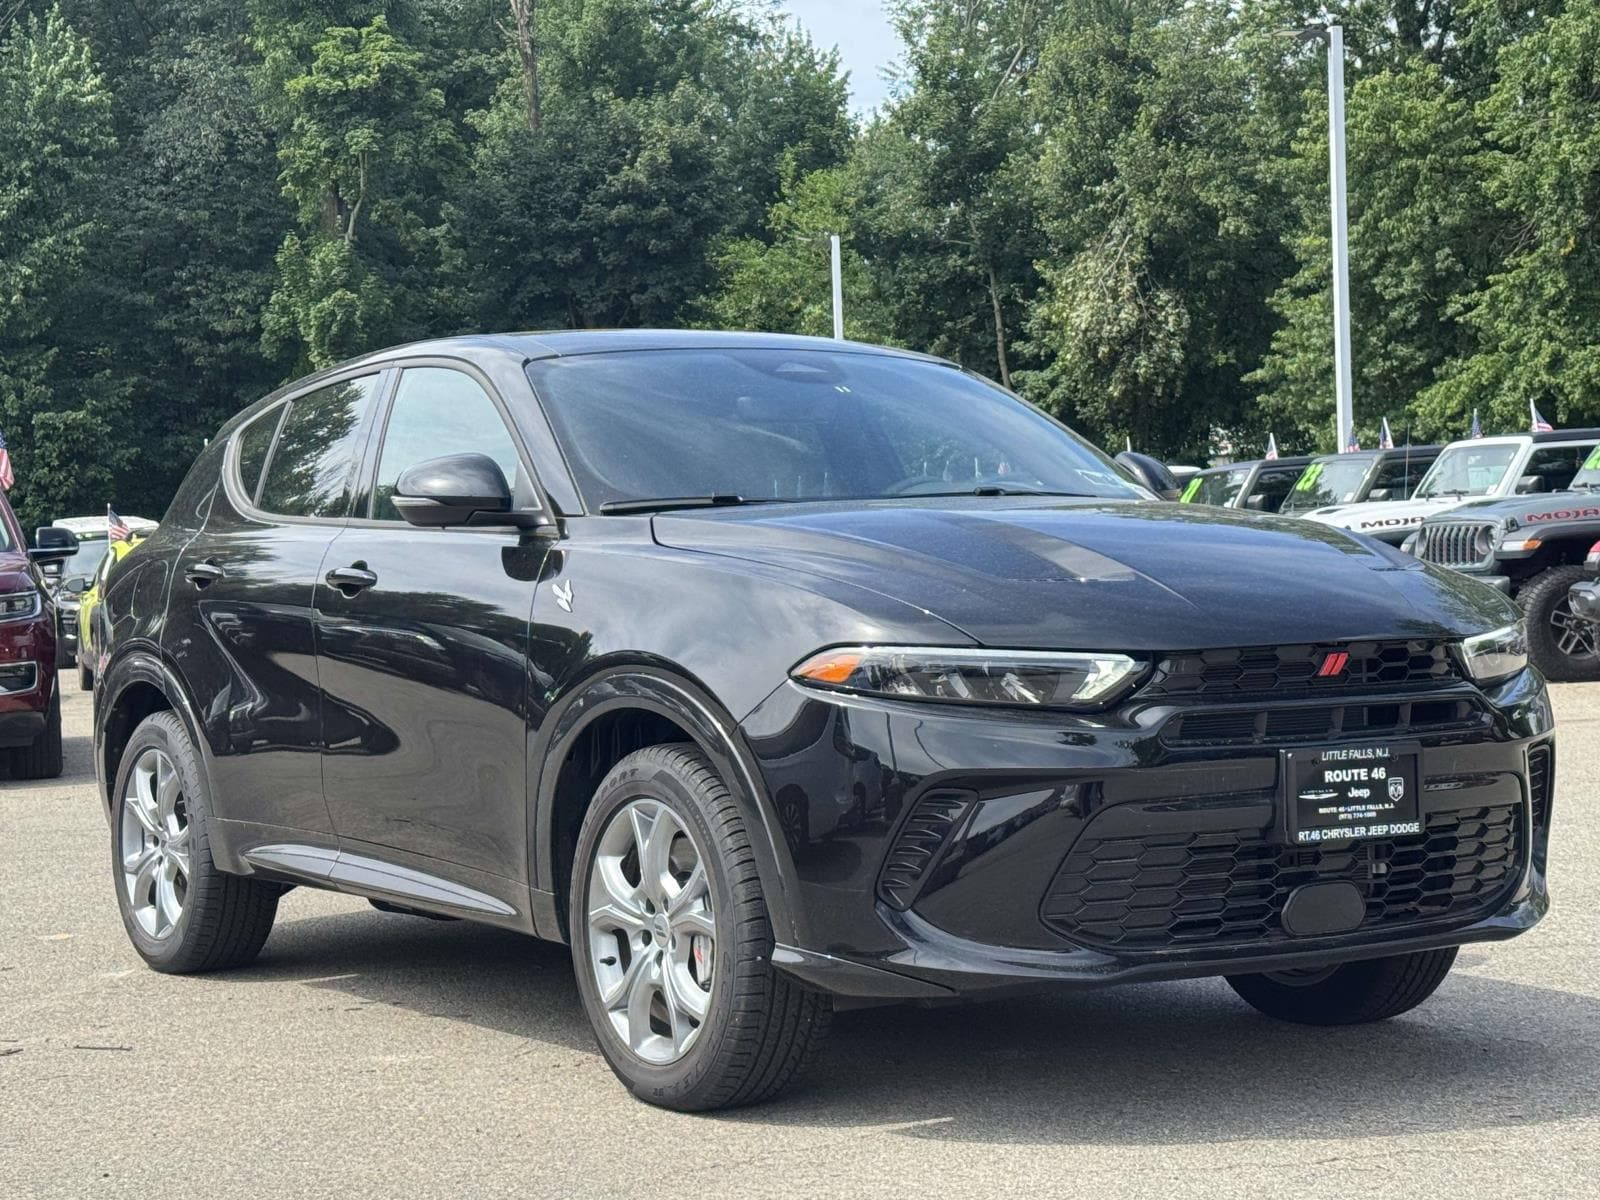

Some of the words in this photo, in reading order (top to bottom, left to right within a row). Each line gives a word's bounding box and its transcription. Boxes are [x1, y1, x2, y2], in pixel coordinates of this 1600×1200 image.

[1321, 750, 1348, 761] LITTLE
[1349, 748, 1375, 760] FALLS,
[1324, 768, 1368, 783] ROUTE
[1371, 767, 1386, 780] 46
[1347, 787, 1370, 799] Jeep
[1322, 827, 1366, 840] CHRYSLER
[1367, 825, 1388, 836] JEEP
[1390, 822, 1420, 835] DODGE
